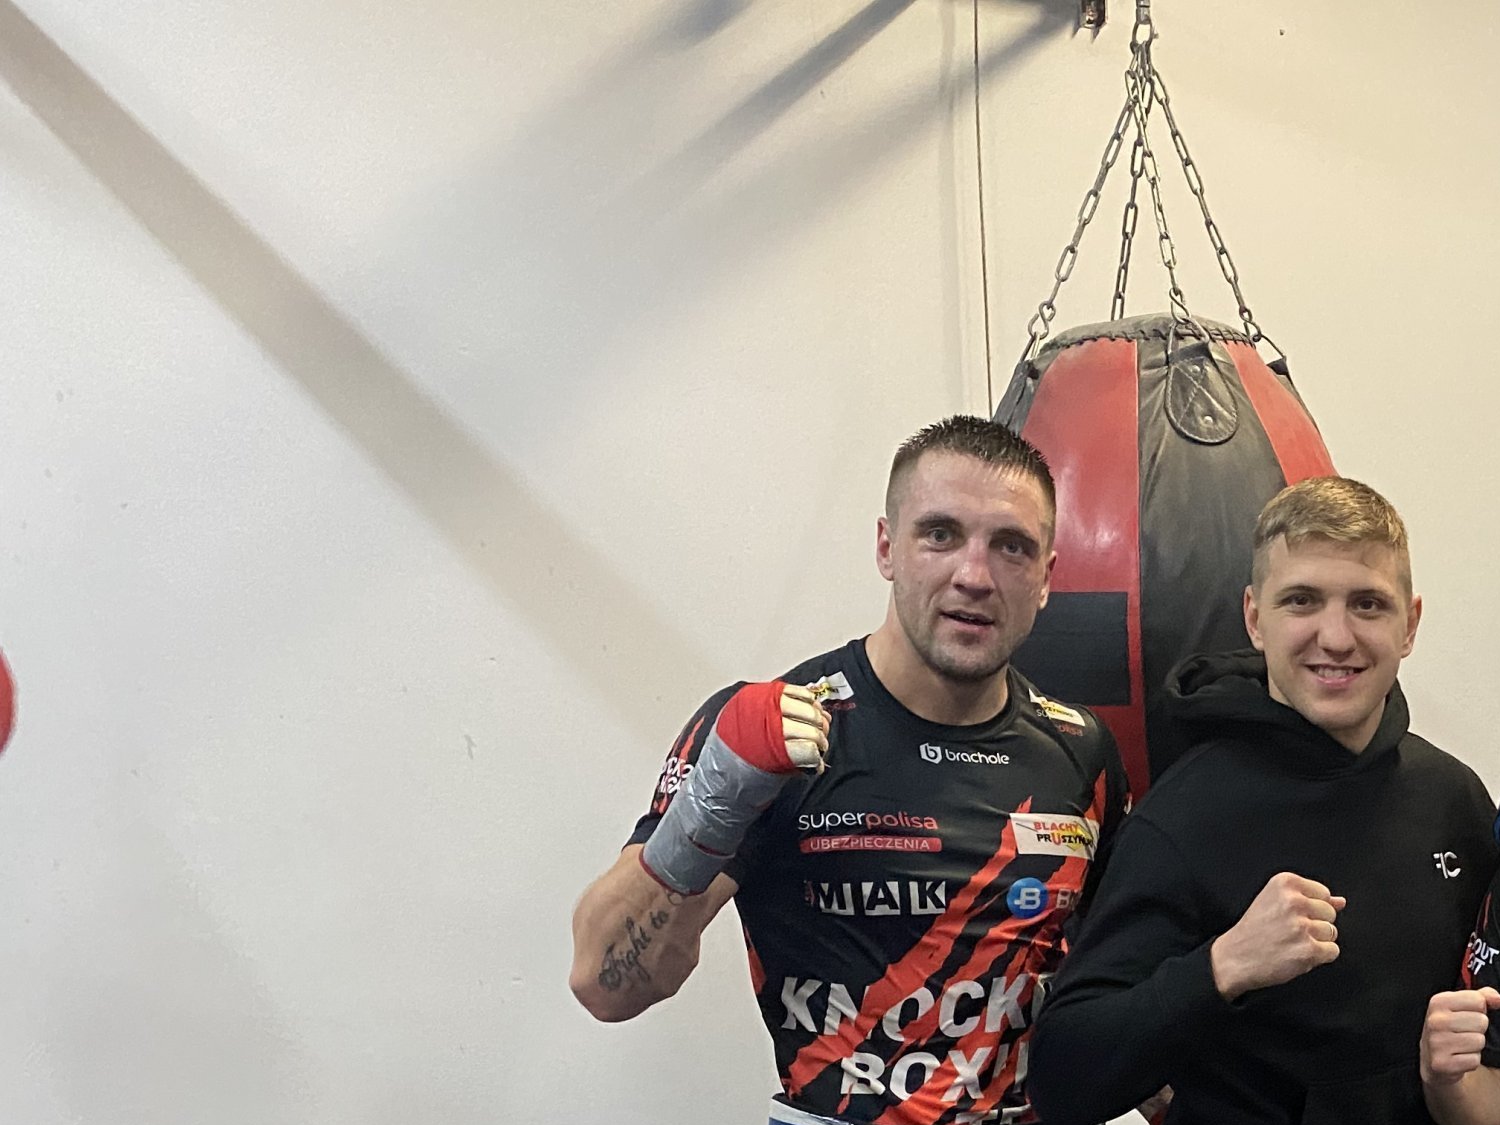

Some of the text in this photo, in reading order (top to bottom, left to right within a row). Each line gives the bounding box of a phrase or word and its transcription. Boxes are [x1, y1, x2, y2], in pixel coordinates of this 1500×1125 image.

[945, 749, 1010, 765] brachole
[798, 811, 938, 832] superpolisa
[1033, 822, 1079, 832] BLACHY
[810, 837, 930, 850] UBEZPIECZENIA
[815, 881, 947, 916] MAK
[781, 973, 1050, 1042] KNOCK
